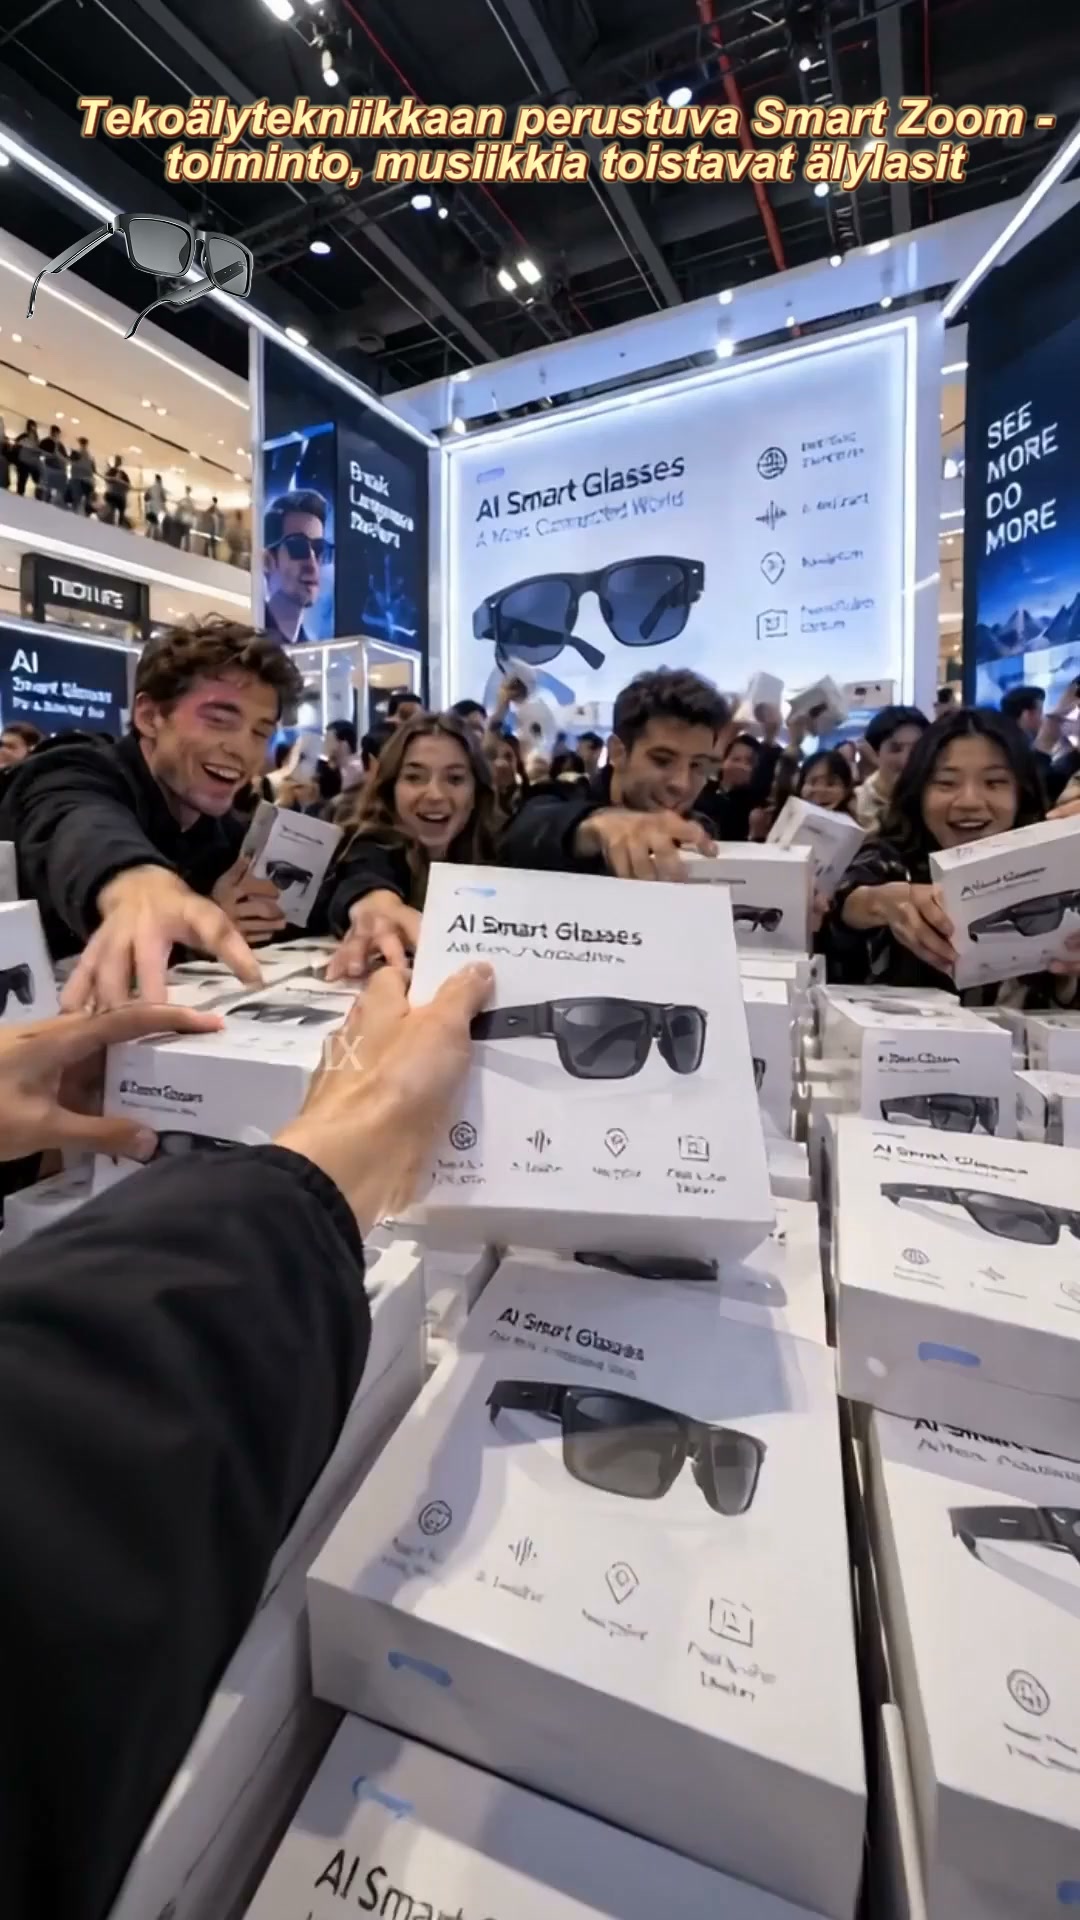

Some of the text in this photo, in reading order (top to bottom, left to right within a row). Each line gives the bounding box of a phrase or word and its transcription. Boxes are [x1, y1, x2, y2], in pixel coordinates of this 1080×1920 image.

[988, 401, 1032, 449] SEE
[987, 423, 1058, 484] MORE
[476, 456, 685, 522] AI Smart Glasses
[986, 482, 1022, 519] DO
[986, 498, 1057, 556] MORE
[10, 648, 39, 674] AI
[447, 914, 642, 946] AI Smart Glasses
[314, 1849, 360, 1900] AI
